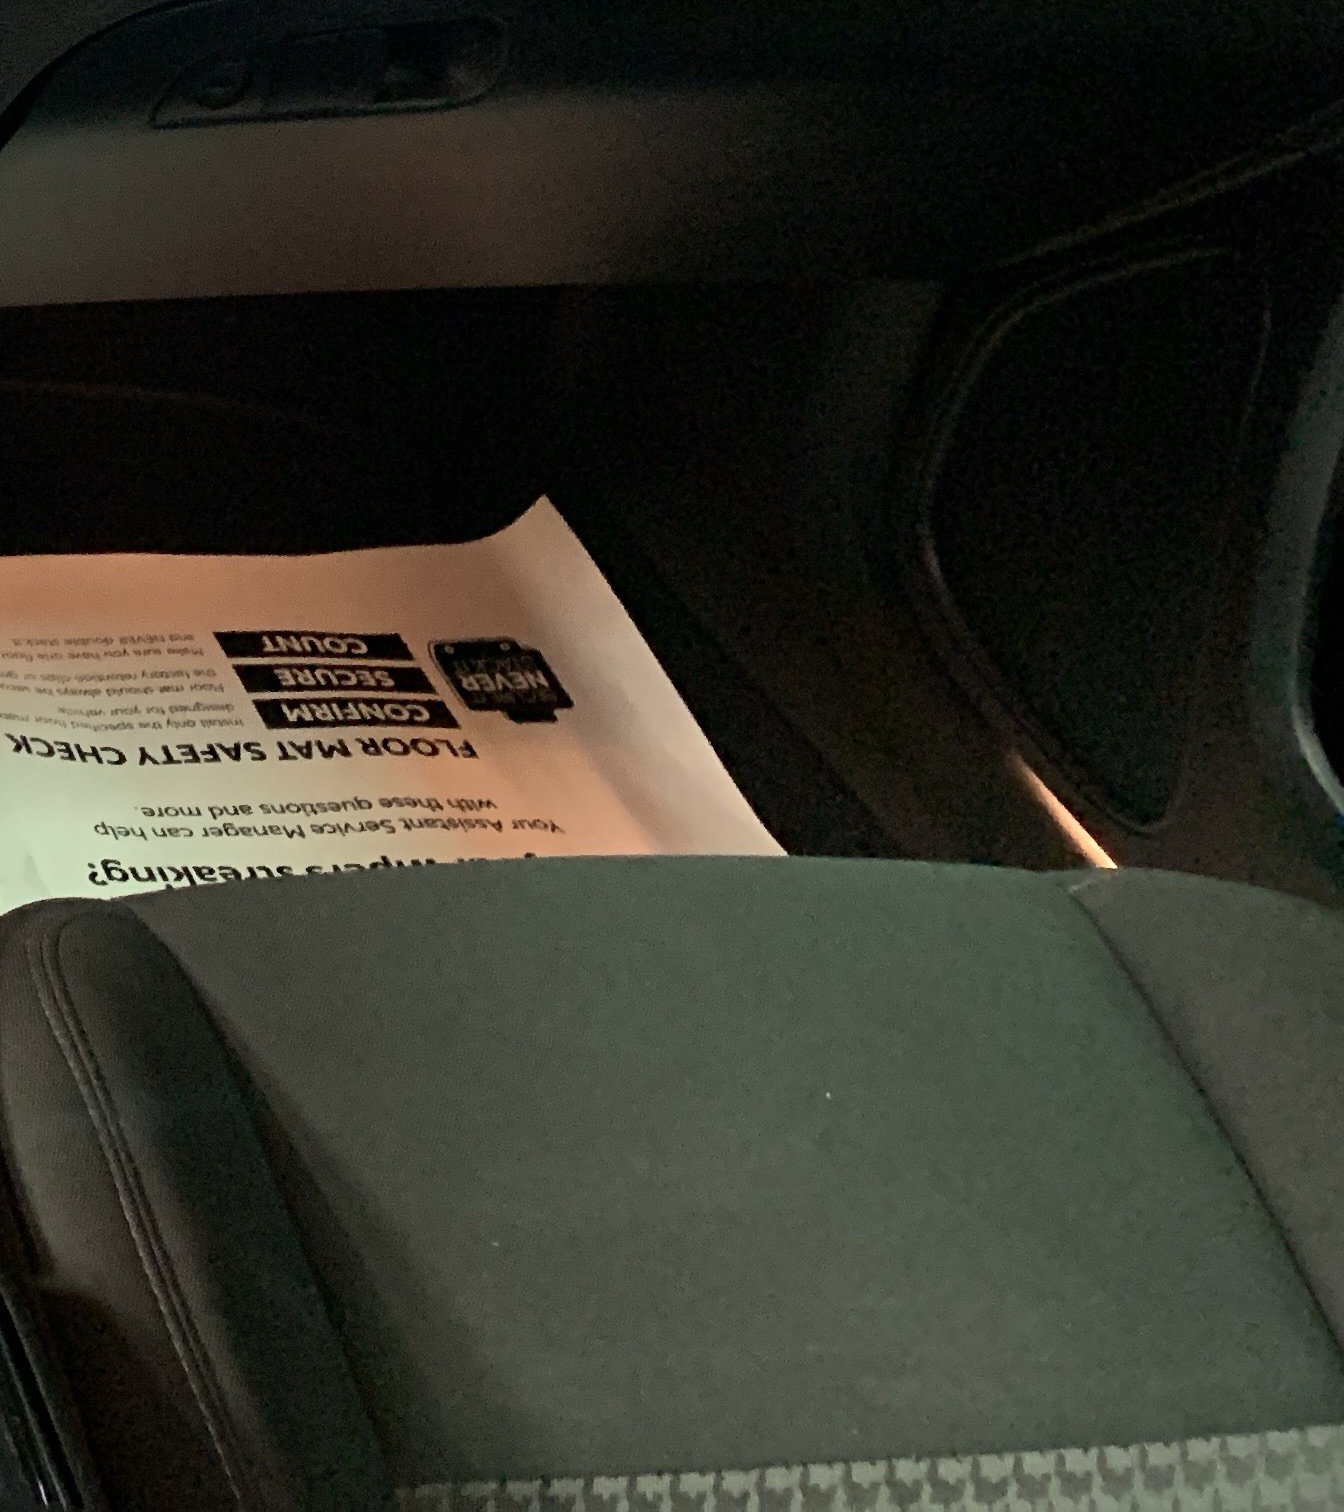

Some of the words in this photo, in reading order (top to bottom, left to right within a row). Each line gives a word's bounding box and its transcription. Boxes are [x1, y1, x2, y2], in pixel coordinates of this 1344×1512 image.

[260, 634, 369, 655] COUNT
[272, 667, 395, 688] SECURE
[457, 669, 550, 692] NEVER
[279, 701, 430, 722] CONFIRM
[4, 732, 128, 766] CHECK
[138, 741, 267, 766] SAFETY
[276, 738, 352, 761] MAT
[354, 736, 480, 760] FLOOR
[207, 804, 254, 820] and
[259, 795, 373, 818] questions
[378, 796, 444, 813] these
[446, 797, 498, 813] with
[93, 822, 148, 841] help
[151, 826, 194, 839] can
[201, 822, 306, 840] Manager
[309, 819, 396, 837] Service
[398, 817, 503, 834] Assistant
[511, 818, 566, 835] Your
